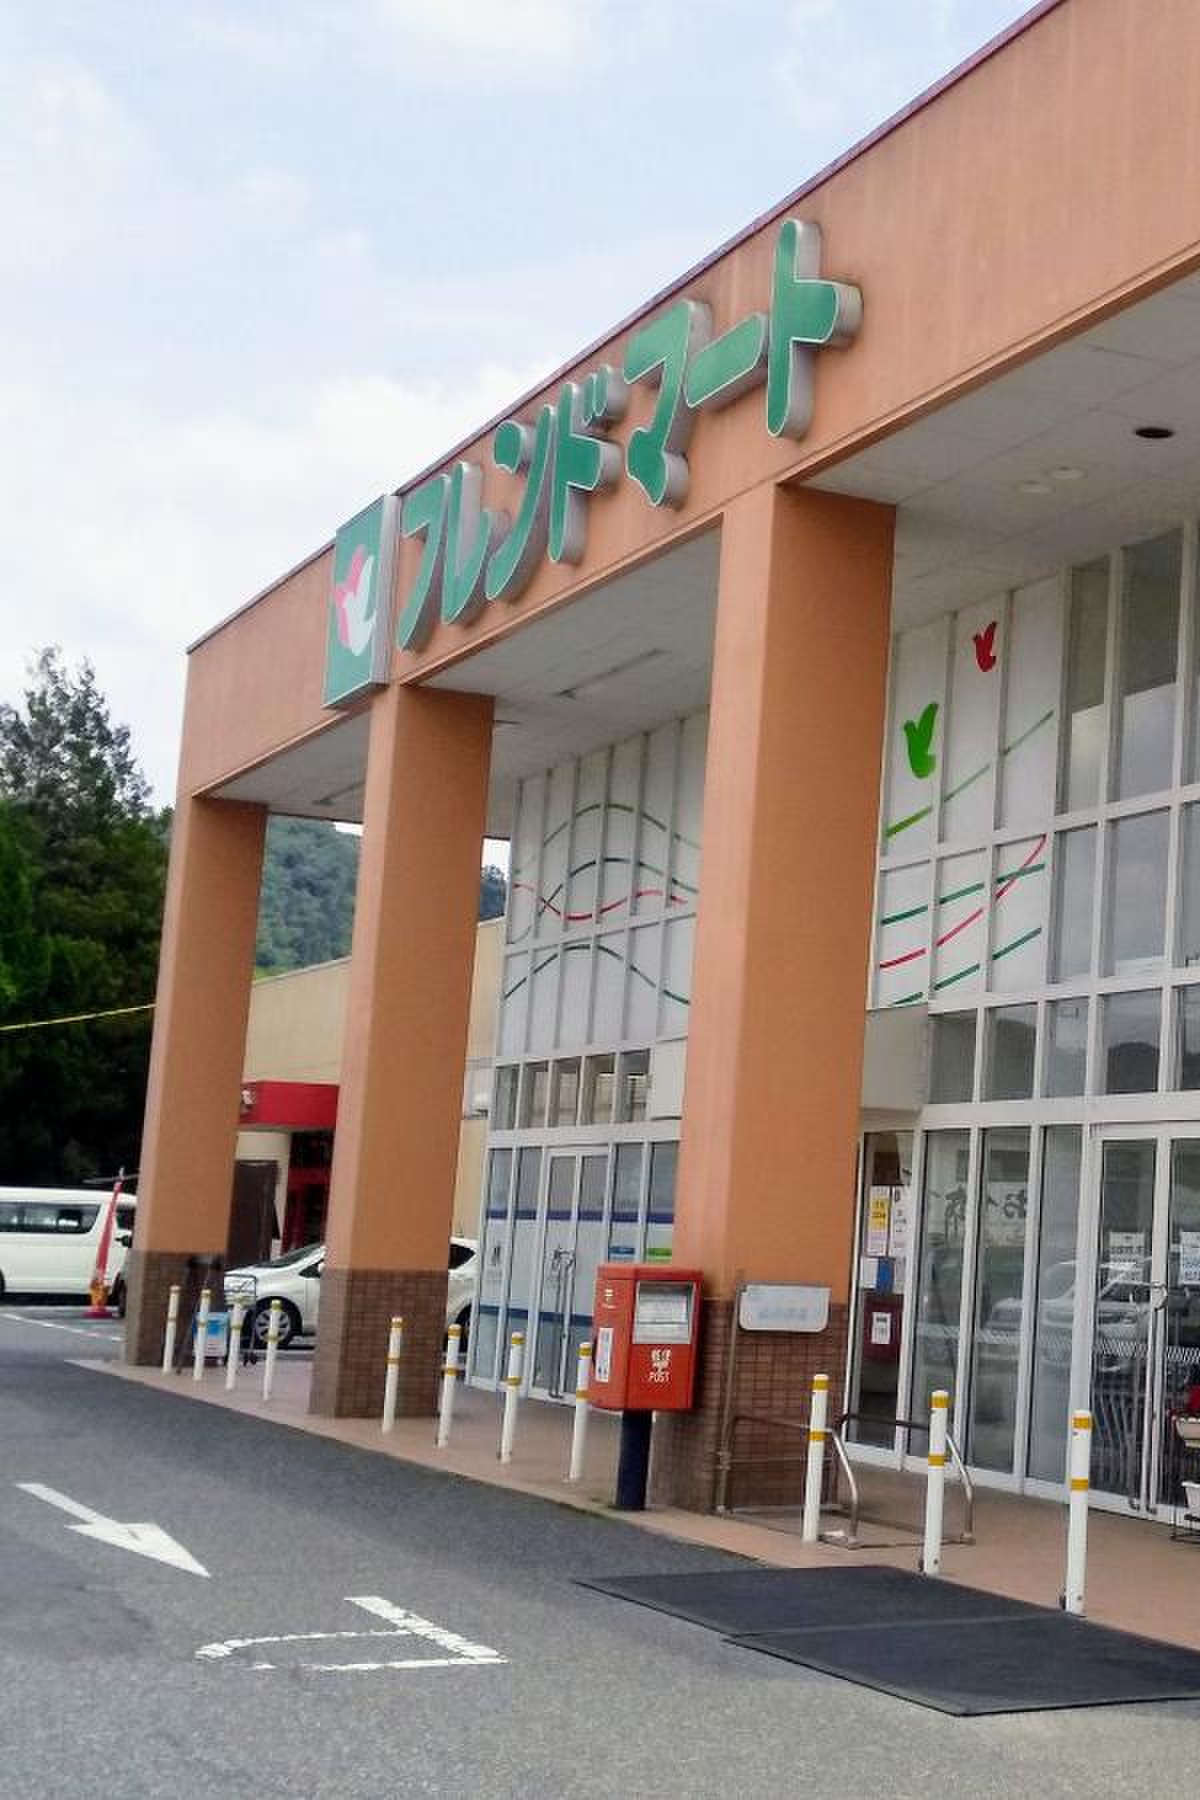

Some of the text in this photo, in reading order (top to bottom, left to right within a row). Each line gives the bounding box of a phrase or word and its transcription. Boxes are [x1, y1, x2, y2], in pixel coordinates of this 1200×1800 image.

[396, 217, 862, 651] フレンドマート
